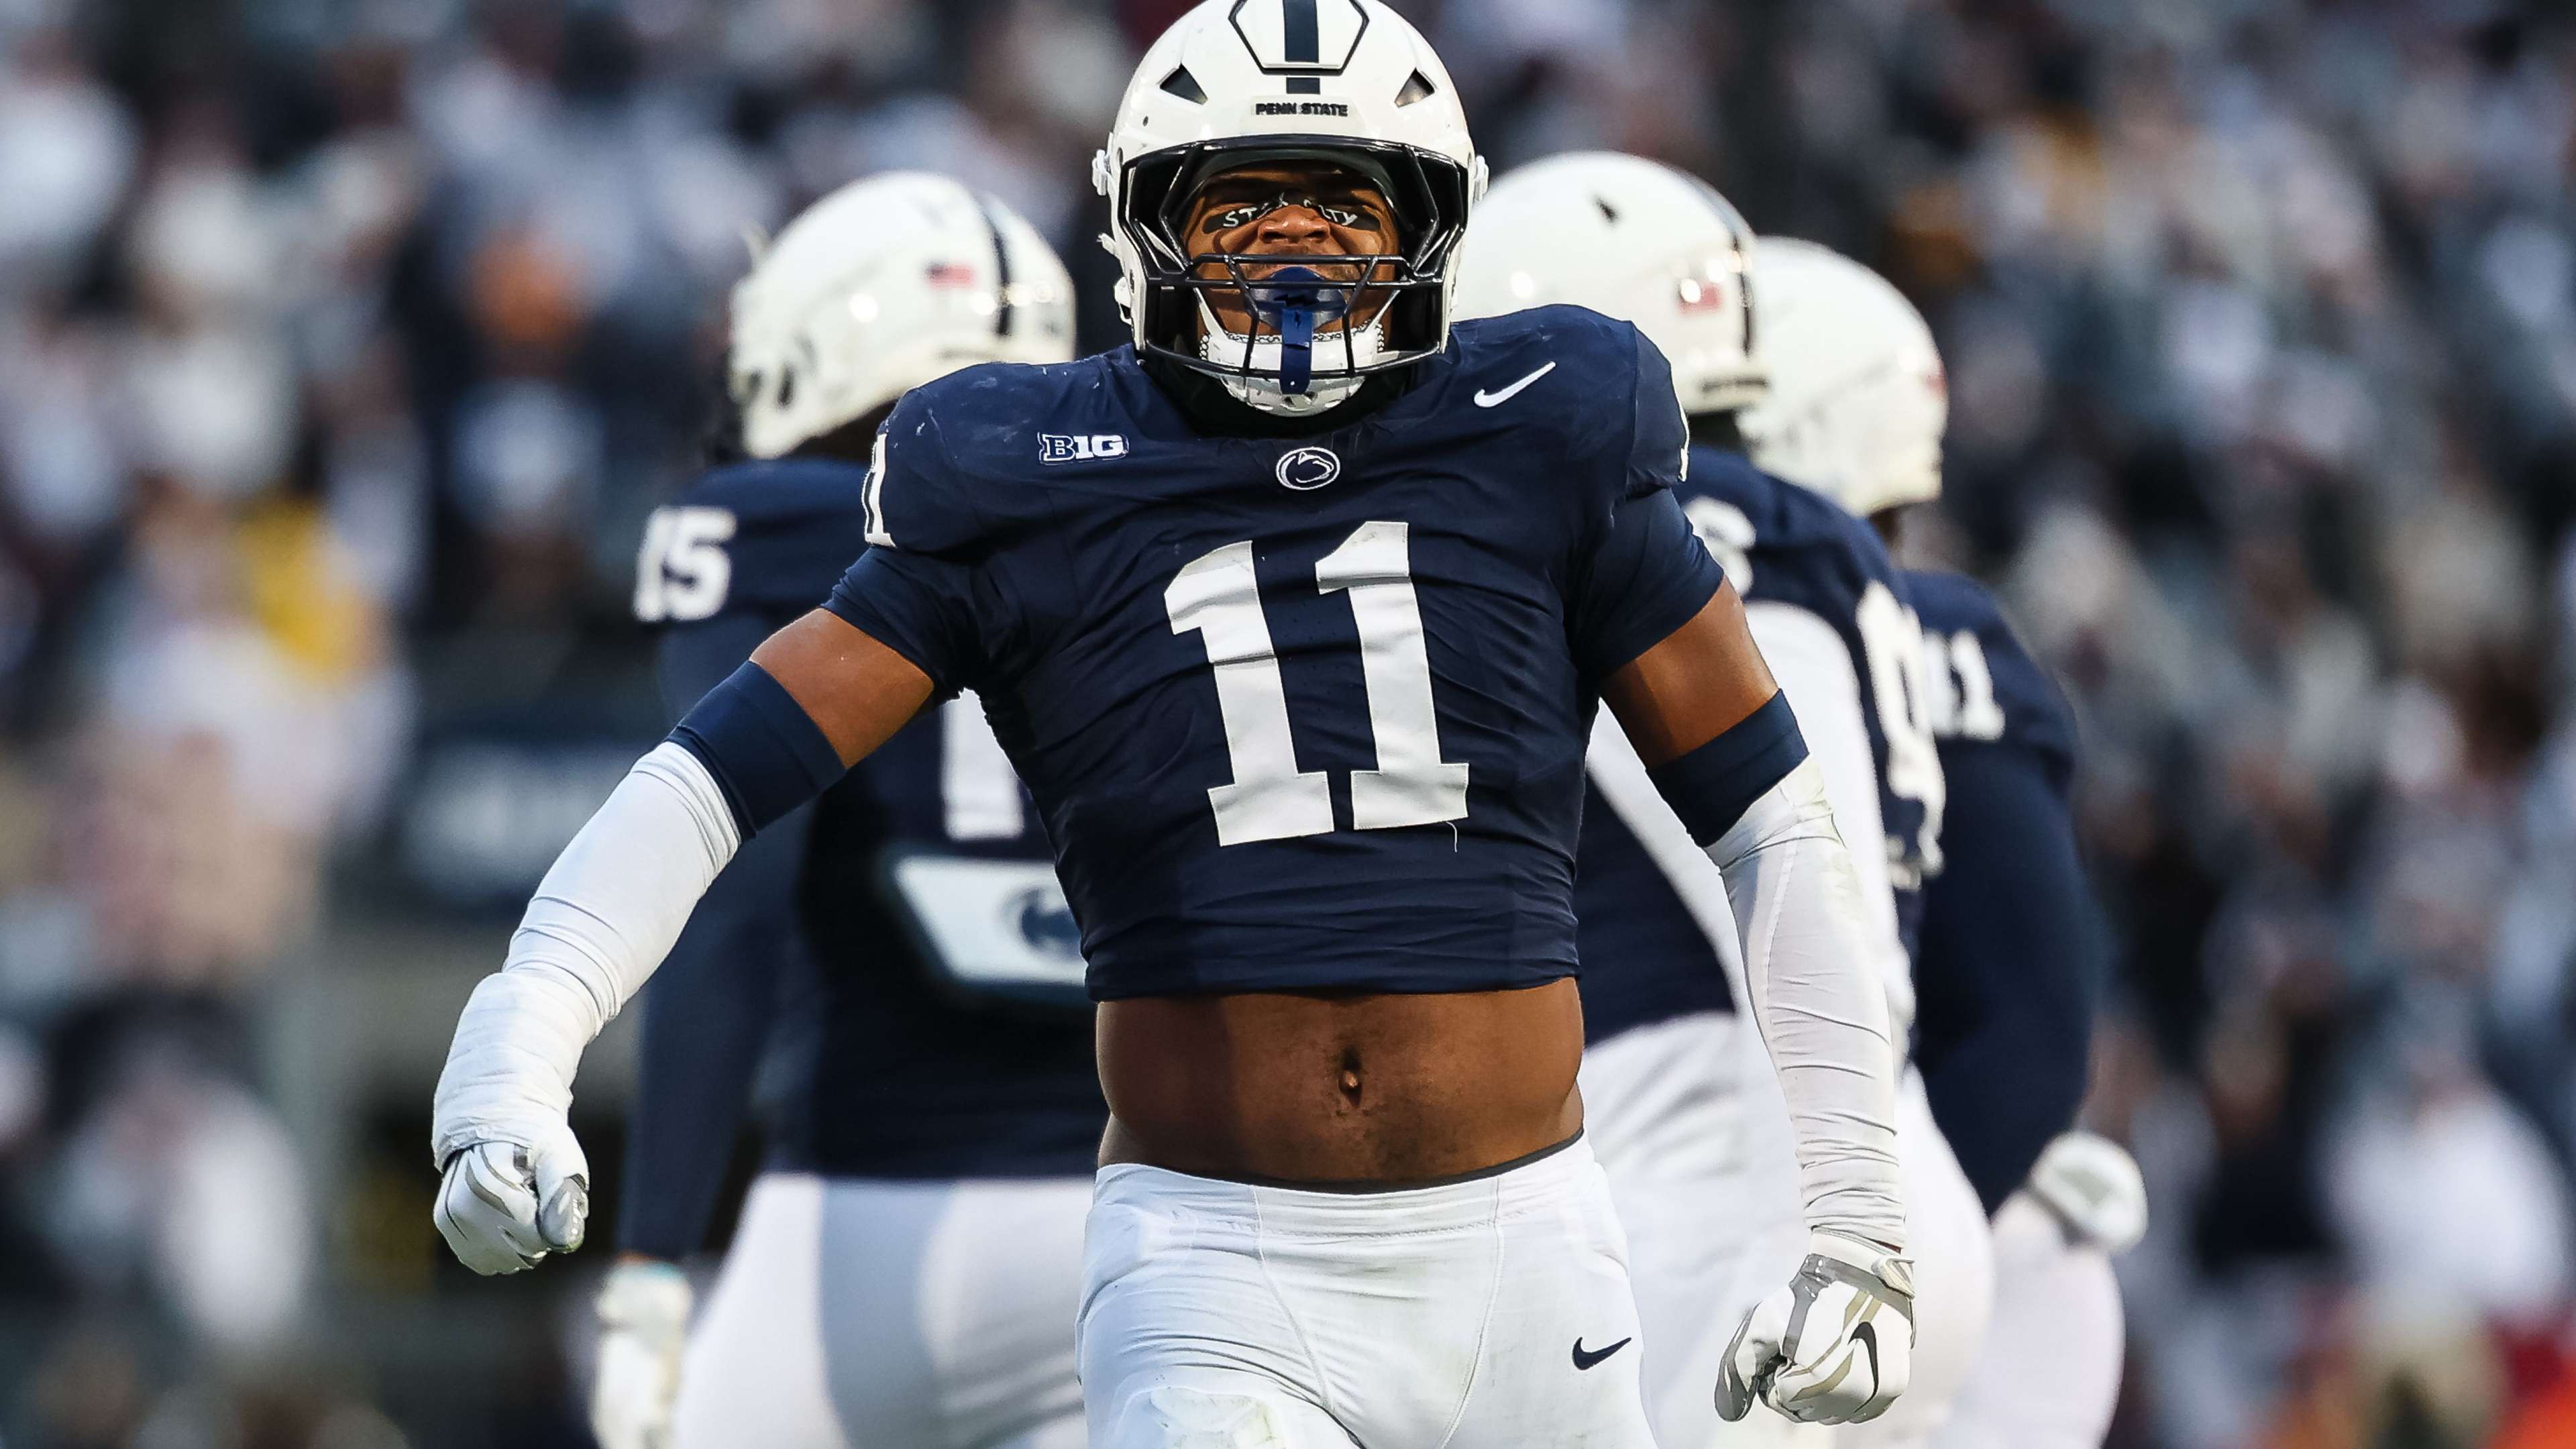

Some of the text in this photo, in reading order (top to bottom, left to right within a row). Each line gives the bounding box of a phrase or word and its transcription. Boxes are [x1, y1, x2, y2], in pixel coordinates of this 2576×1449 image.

[1255, 102, 1348, 117] PENN STATE
[633, 504, 737, 622] 15
[1164, 521, 1470, 847] 11
